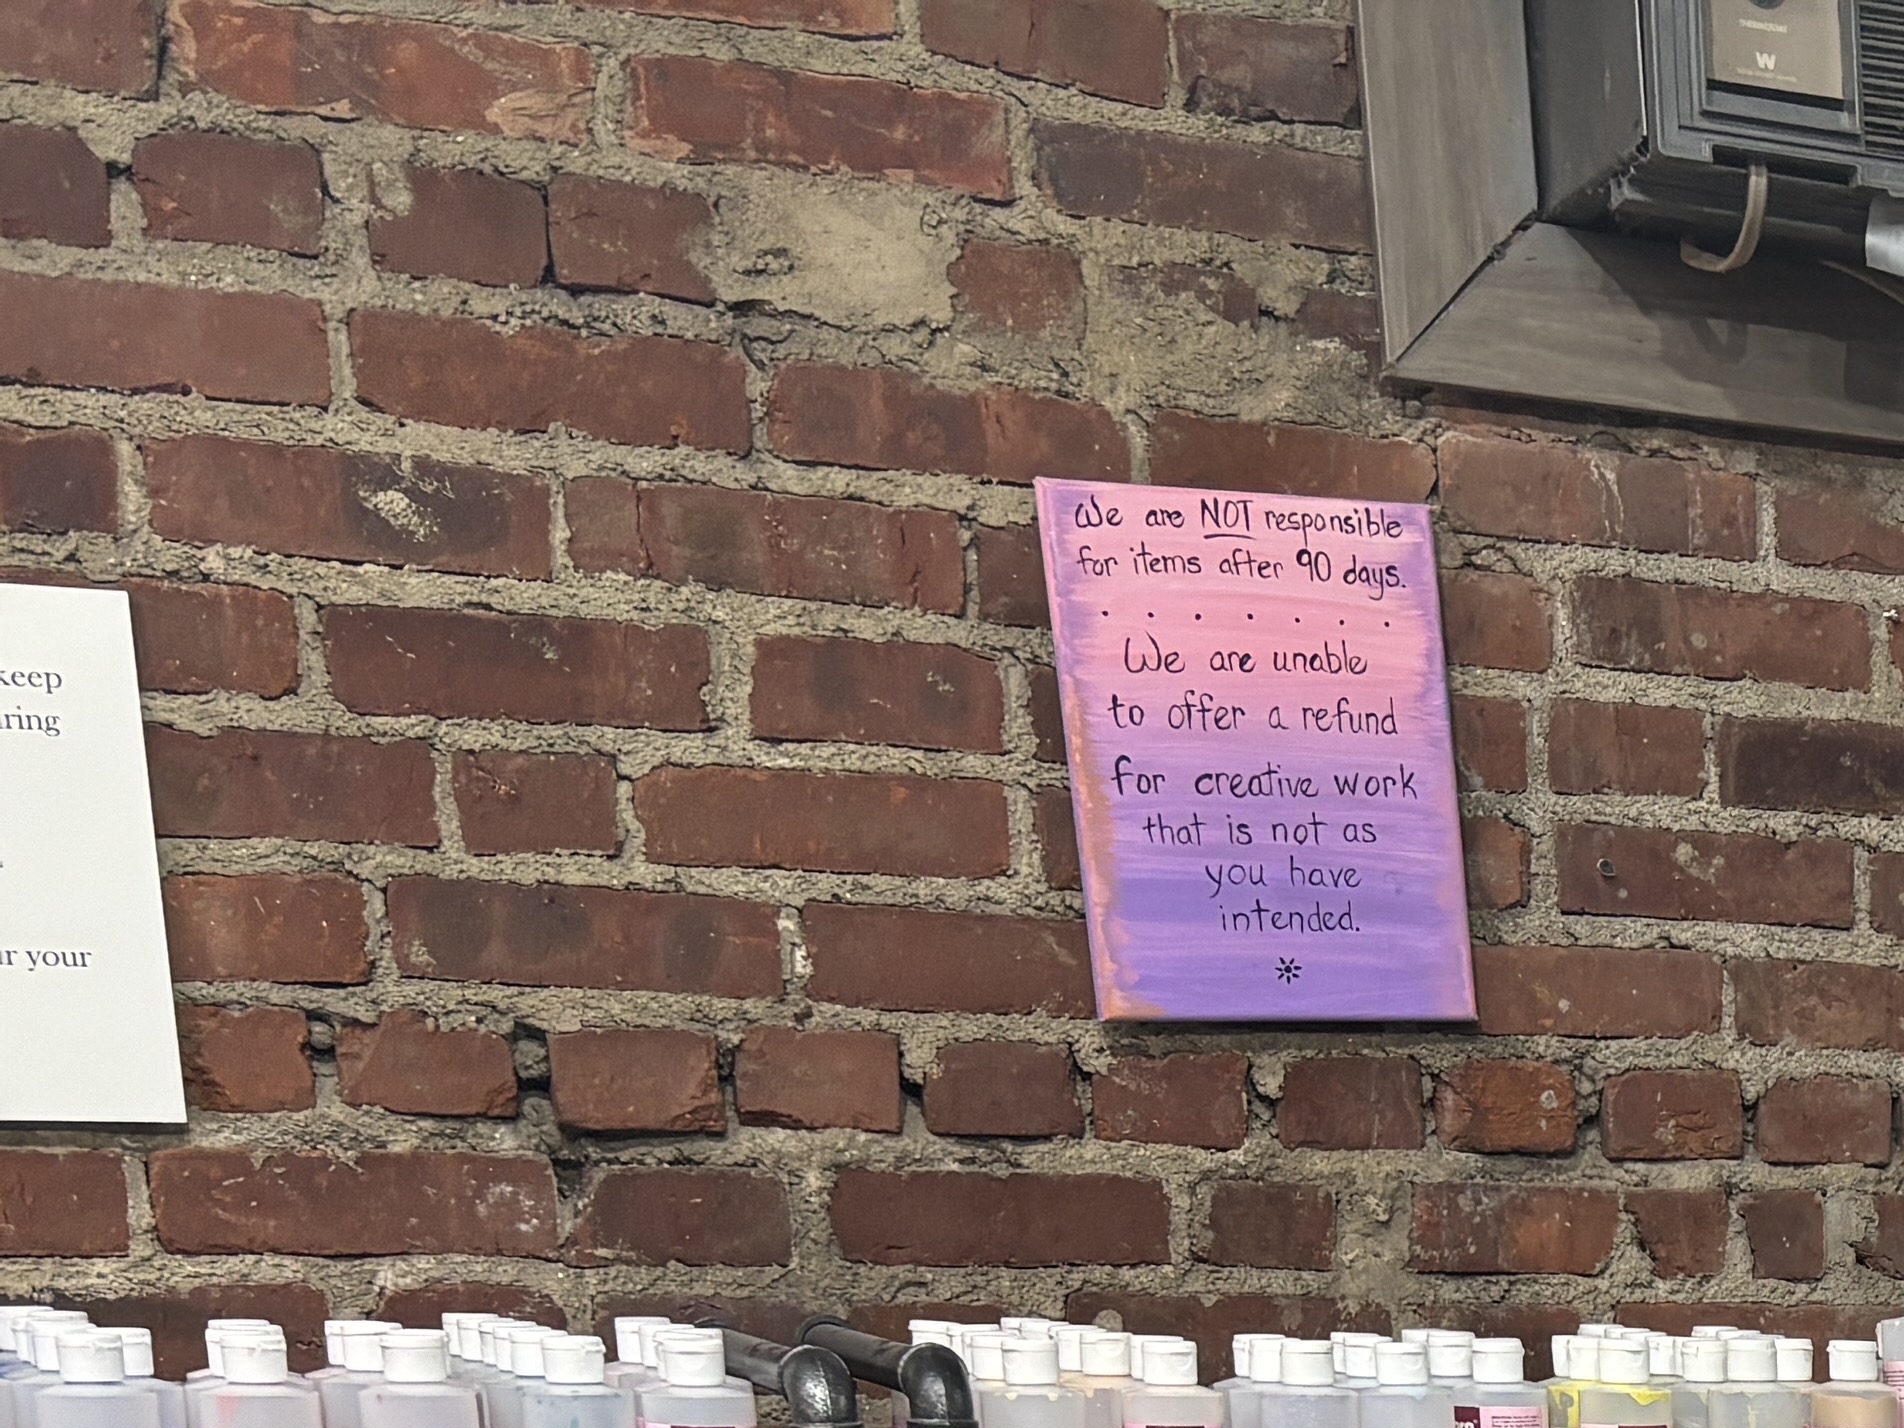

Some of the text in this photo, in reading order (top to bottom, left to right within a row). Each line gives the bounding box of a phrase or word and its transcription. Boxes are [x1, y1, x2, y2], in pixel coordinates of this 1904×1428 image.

[1074, 498, 1403, 544] We are NOT responsible
[1077, 546, 1407, 600] for items after 90 days.
[1123, 630, 1368, 675] We are unable
[1107, 689, 1399, 735] to offer a refund
[1111, 755, 1418, 800] for creative work
[1142, 813, 1377, 846] that is not as
[1205, 855, 1362, 898] you have
[1220, 901, 1361, 933] intended.
[25, 949, 92, 971] your
